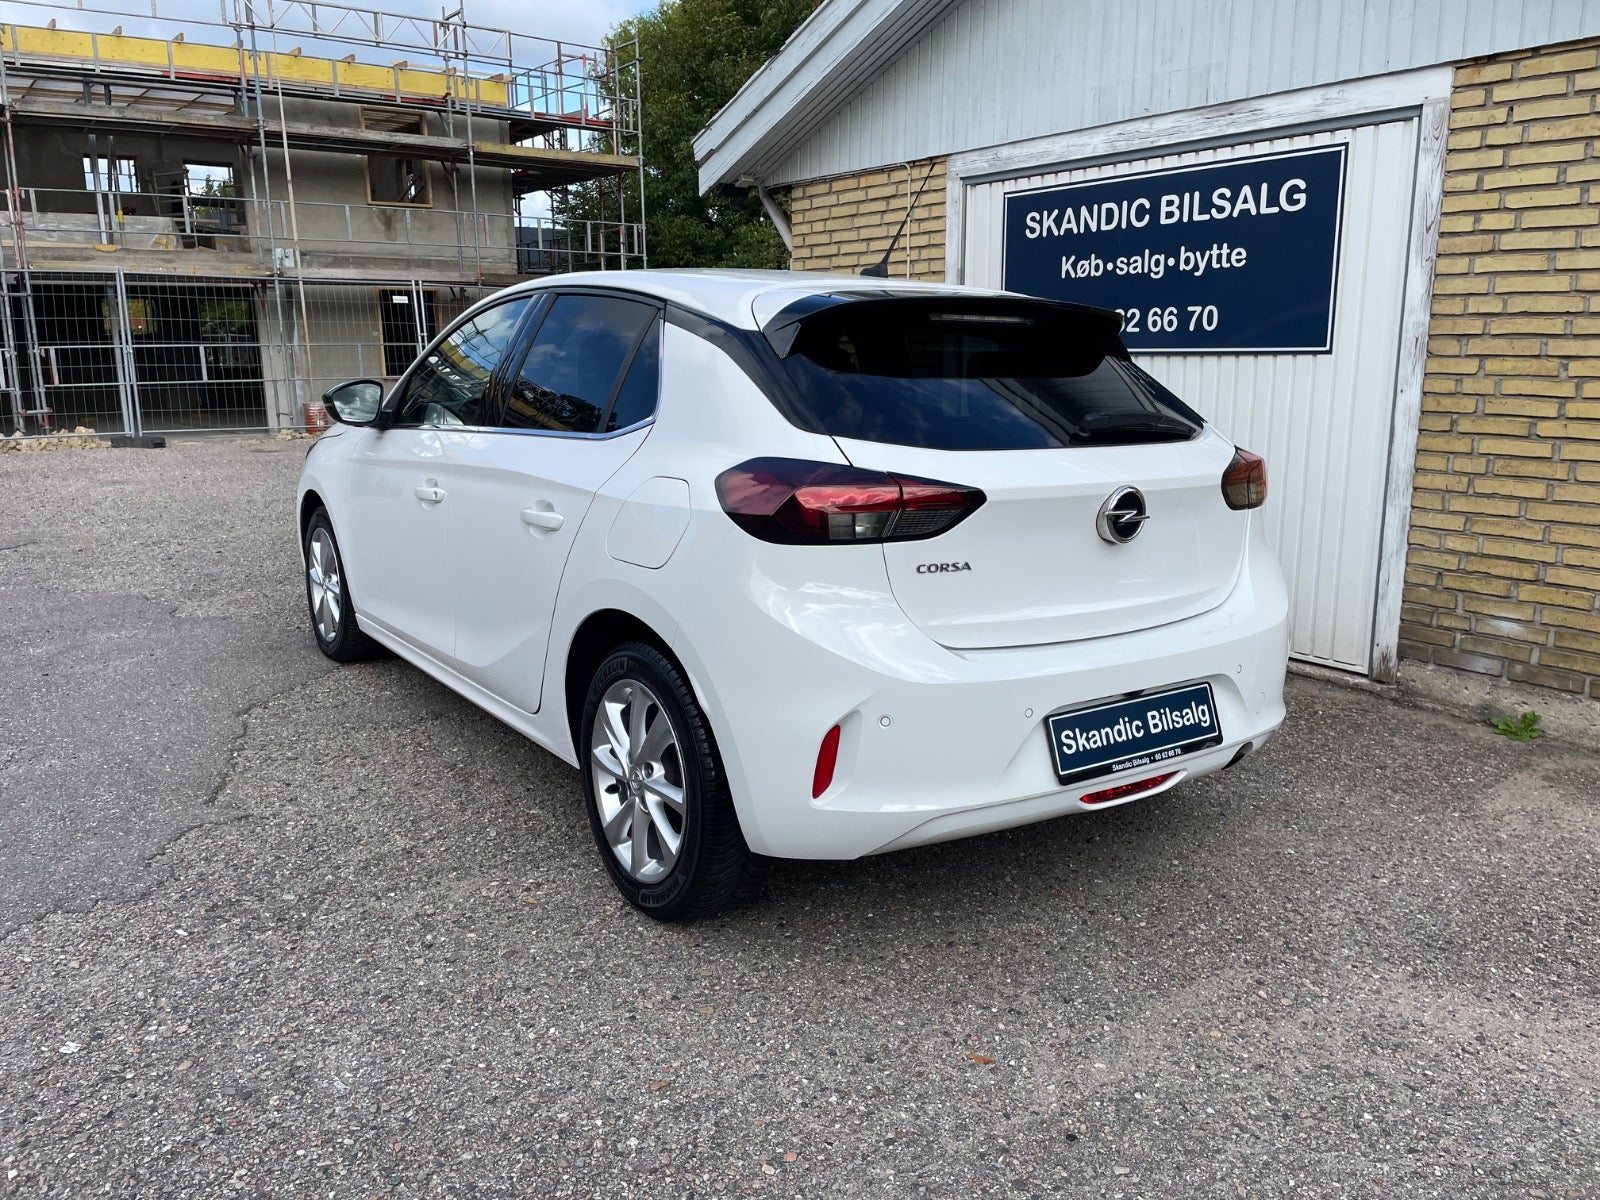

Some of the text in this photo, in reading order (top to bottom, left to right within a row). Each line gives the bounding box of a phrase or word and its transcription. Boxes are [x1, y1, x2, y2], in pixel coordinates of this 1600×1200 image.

[1024, 178, 1308, 239] SKANDIC BILSALG
[1147, 306, 1178, 333] 66
[1187, 304, 1219, 332] 70
[916, 561, 972, 574] CORSA
[1060, 701, 1211, 755] Skandic Bilsalg
[1111, 761, 1133, 772] Skandic
[1132, 756, 1150, 767] Bilsalg
